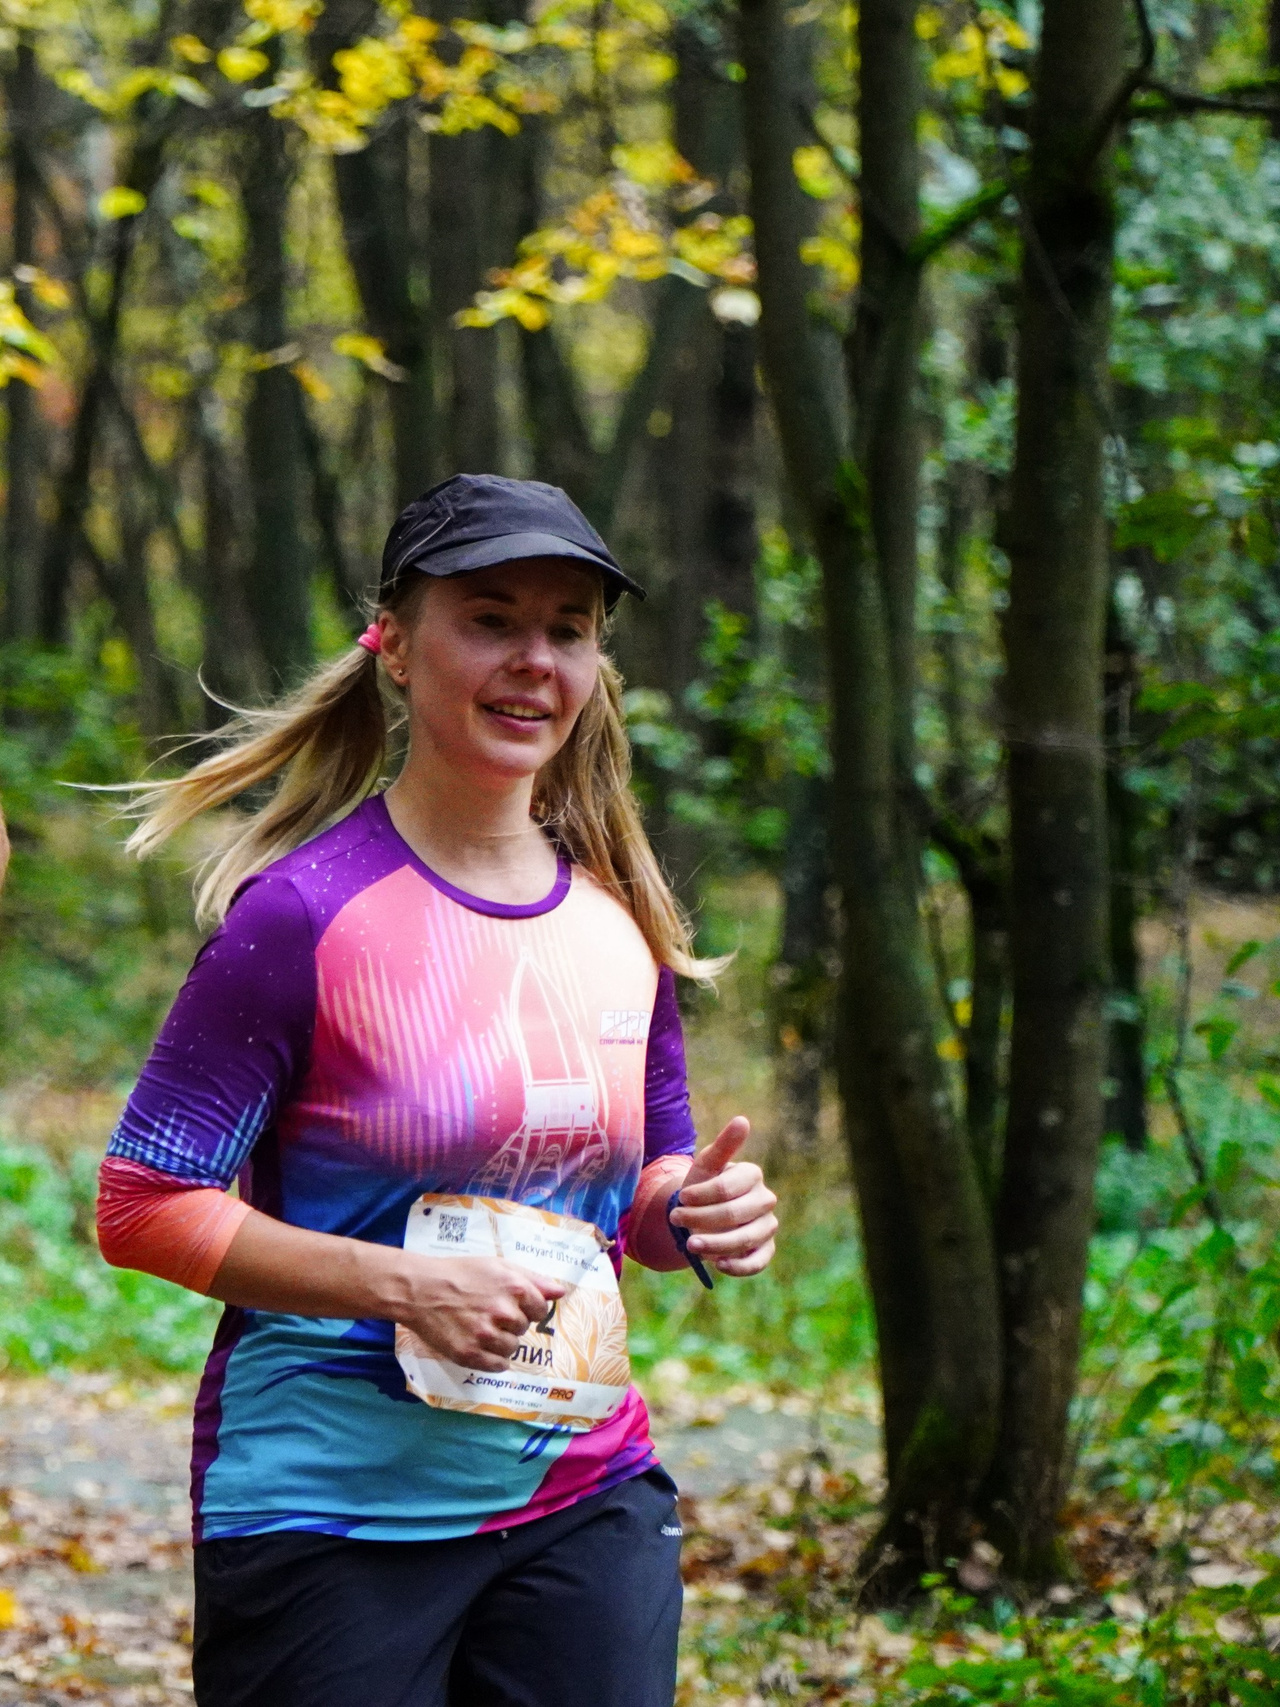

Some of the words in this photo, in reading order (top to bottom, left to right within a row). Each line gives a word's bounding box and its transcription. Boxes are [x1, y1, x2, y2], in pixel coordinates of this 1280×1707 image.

[515, 1241, 554, 1259] Backyard
[556, 1251, 579, 1267] Ultra
[535, 1299, 557, 1337] 2
[511, 1344, 554, 1368] лия
[476, 1376, 549, 1395] спортмастер
[549, 1387, 574, 1400] PRO
